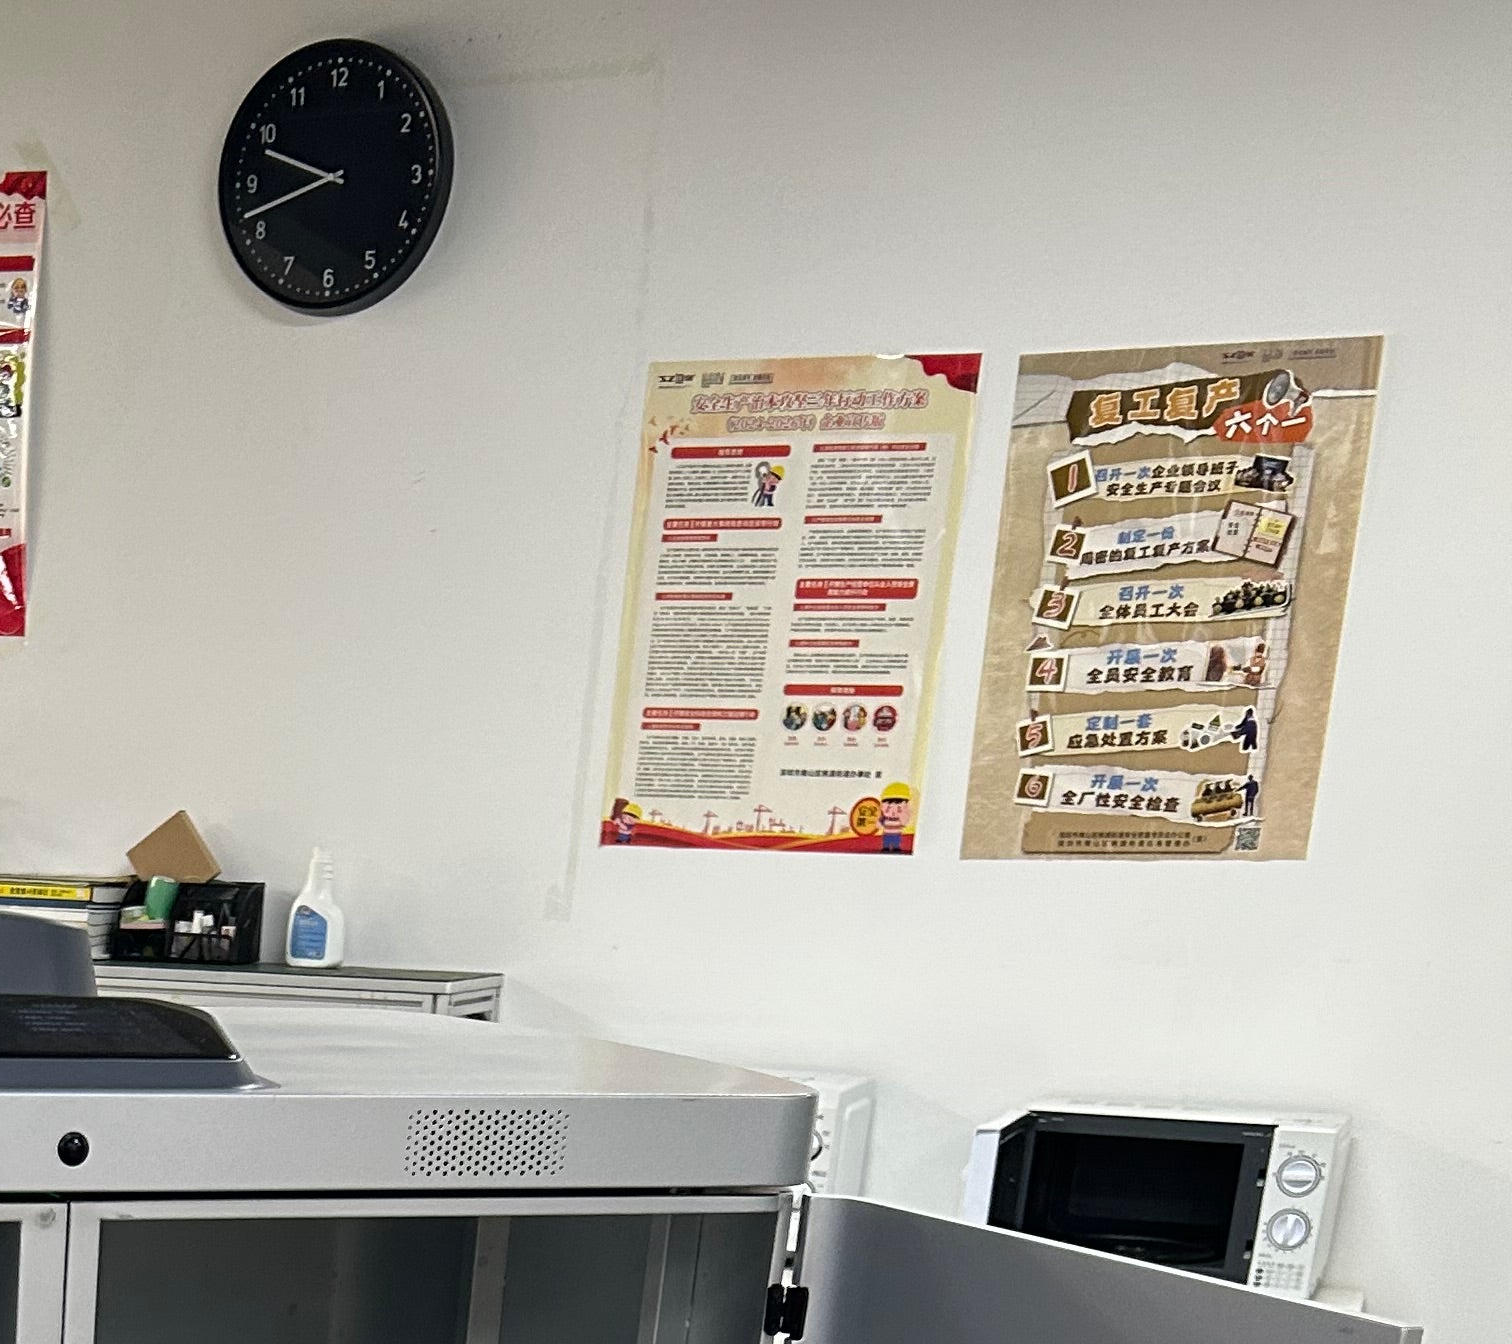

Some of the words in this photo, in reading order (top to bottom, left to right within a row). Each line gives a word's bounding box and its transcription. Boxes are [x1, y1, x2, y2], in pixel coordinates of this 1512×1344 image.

[330, 67, 349, 87] 12
[290, 87, 306, 106] 11
[377, 80, 385, 99] 1
[400, 113, 411, 133] 2
[259, 124, 277, 144] 10
[247, 175, 258, 193] 9
[411, 164, 422, 184] 3
[398, 210, 408, 229] 4
[255, 221, 266, 239] 8
[284, 256, 295, 275] 7
[364, 250, 376, 269] 5
[323, 269, 334, 288] 6
[1088, 378, 1240, 428] 复工复产
[1224, 410, 1306, 439] 六个一
[1106, 477, 1221, 496] 安全生产专题会议
[1056, 532, 1078, 558] 2
[1117, 526, 1175, 546] 制定一份
[1080, 538, 1212, 566] 周密的复工复产方案
[1118, 583, 1184, 601] 召开一次
[1043, 590, 1066, 619] 3
[1098, 602, 1199, 620] 全体员工大会
[1106, 648, 1178, 667] 开展一次
[1035, 658, 1058, 683] 4
[1086, 664, 1194, 686] 全员安全教育
[1084, 712, 1153, 732] 定制一套
[1025, 722, 1042, 747] 5
[1066, 730, 1168, 750] 应急处置方案
[1025, 776, 1042, 797] 6
[1090, 774, 1160, 792] 开展一次
[1060, 790, 1180, 814] 全厂性安全检查
